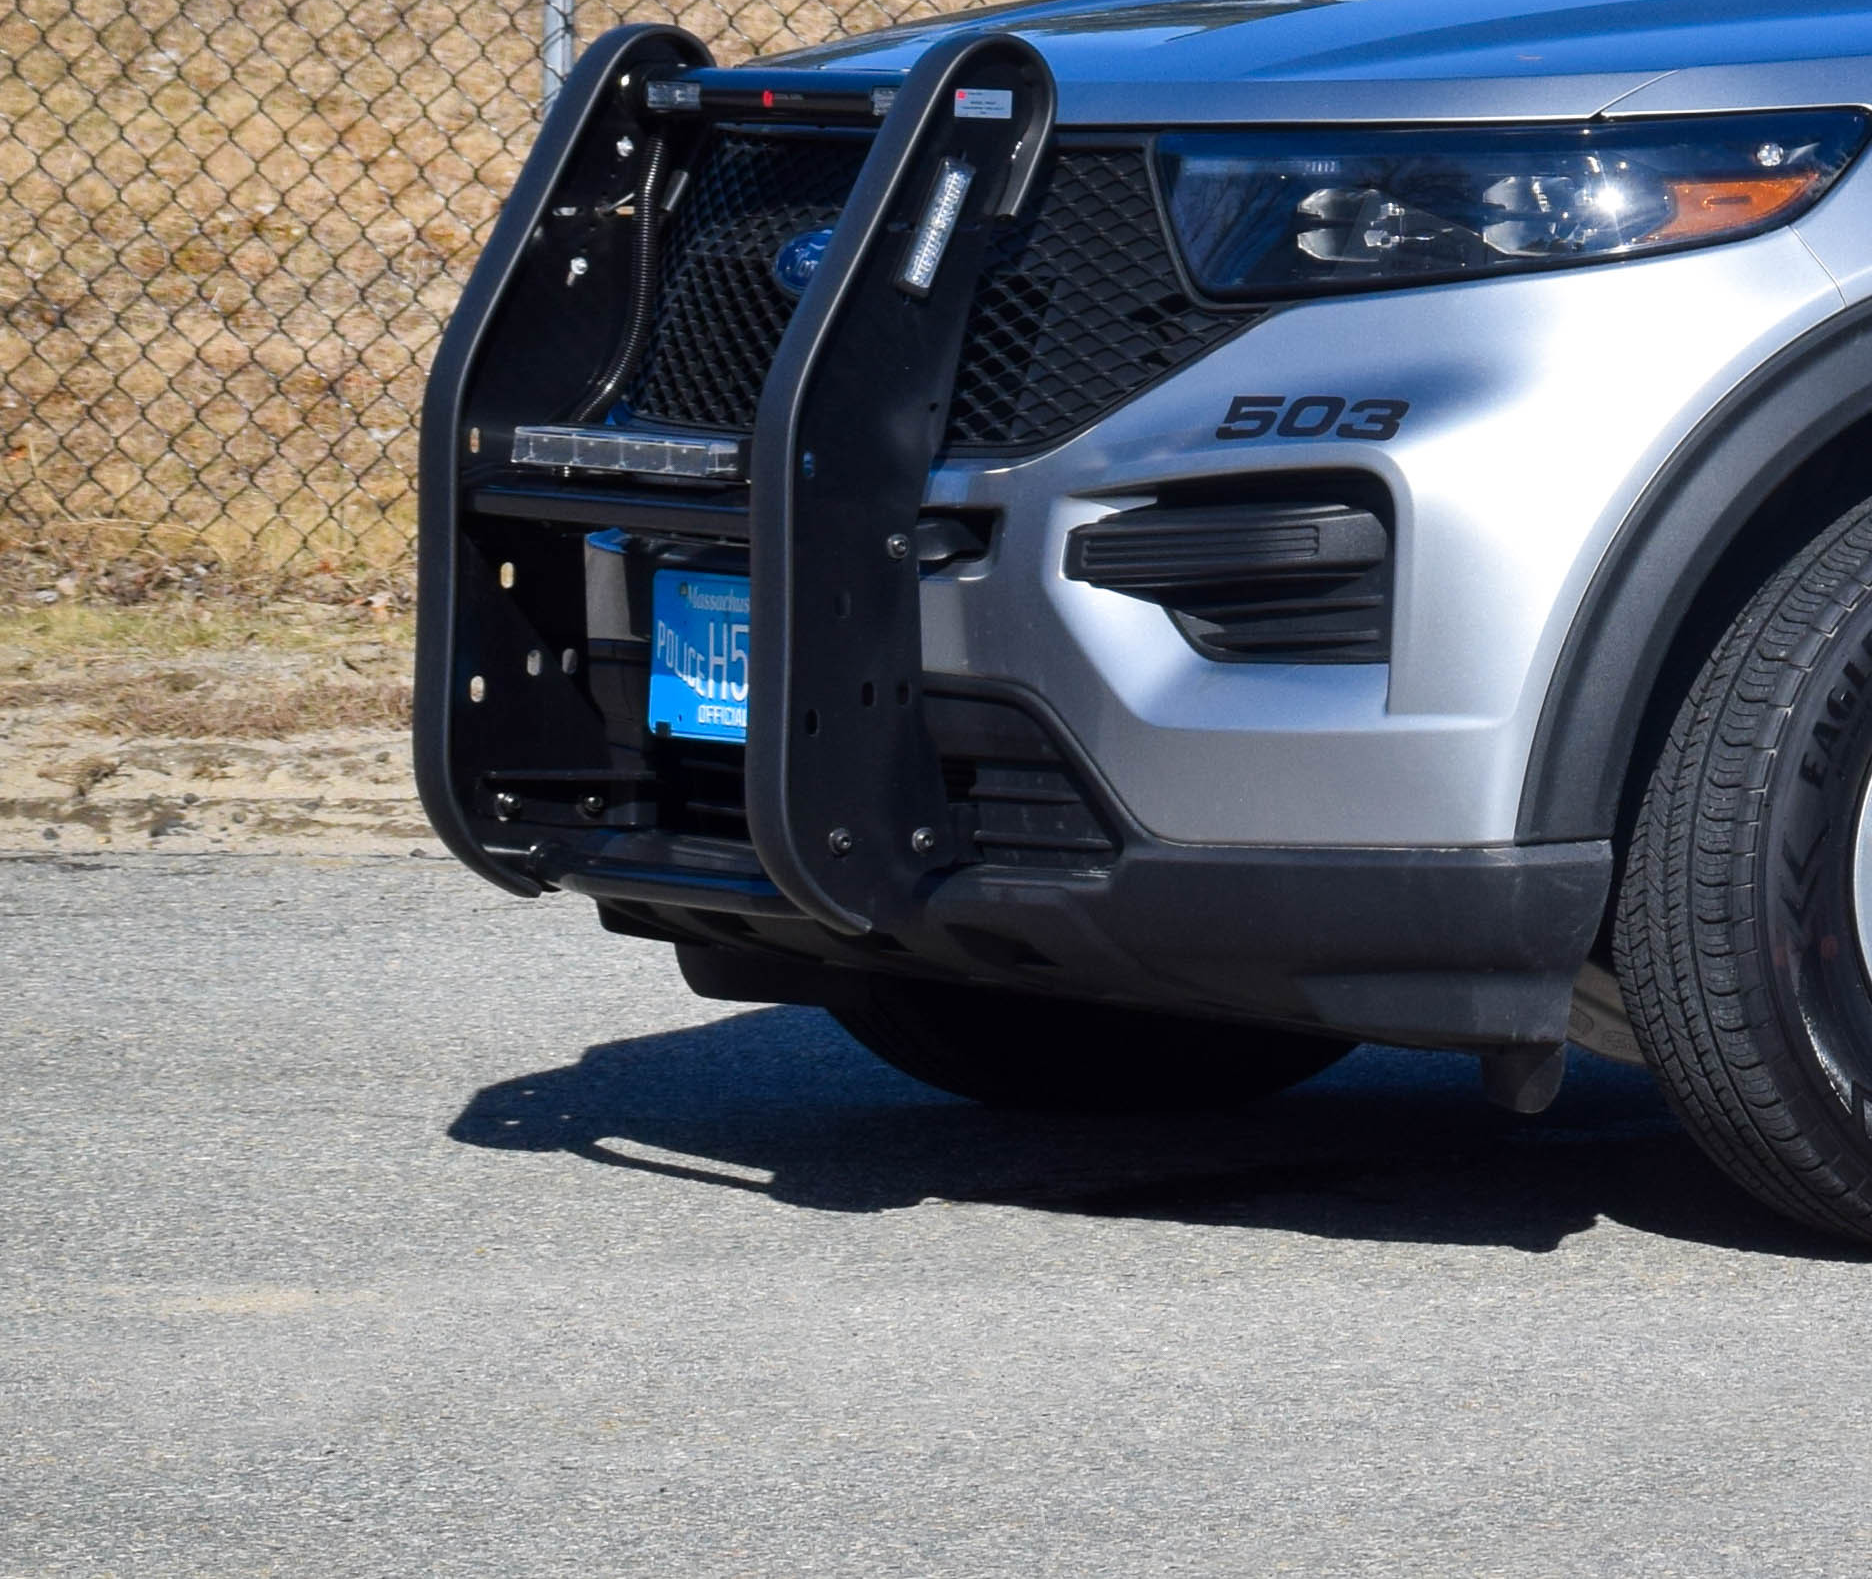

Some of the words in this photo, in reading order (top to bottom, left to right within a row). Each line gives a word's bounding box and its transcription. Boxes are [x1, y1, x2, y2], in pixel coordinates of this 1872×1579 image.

[1215, 395, 1411, 442] 503
[656, 619, 706, 697] POLICE
[708, 620, 750, 702] H5
